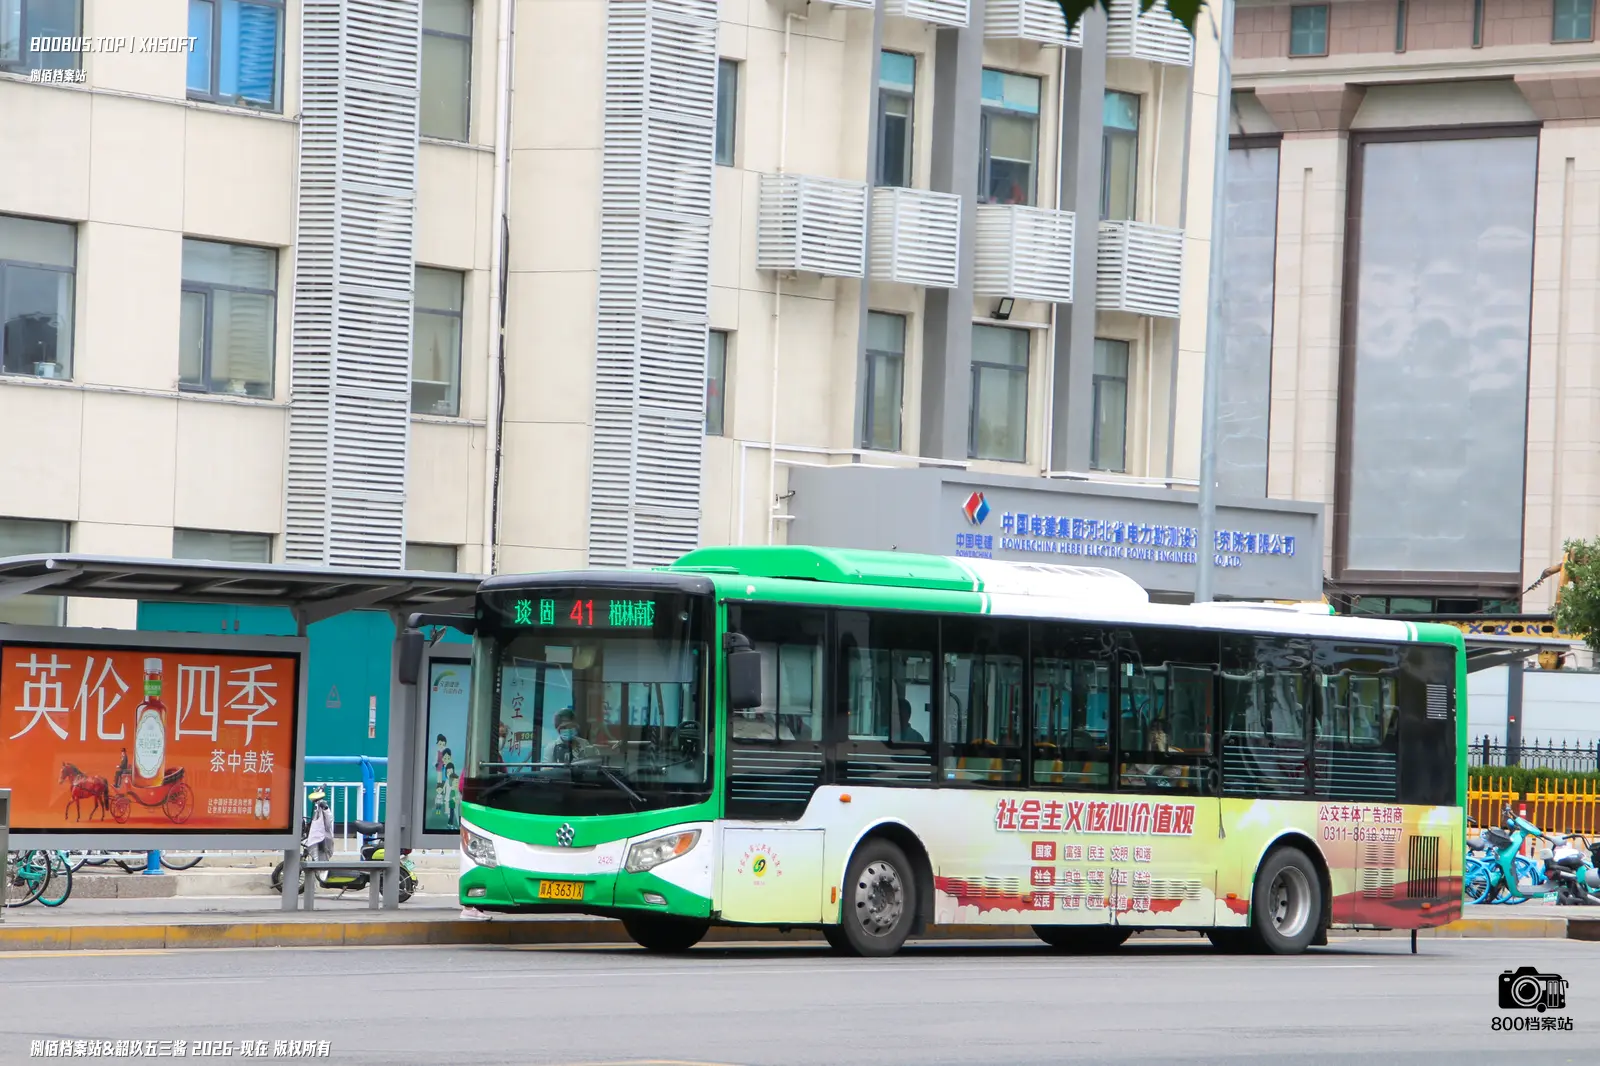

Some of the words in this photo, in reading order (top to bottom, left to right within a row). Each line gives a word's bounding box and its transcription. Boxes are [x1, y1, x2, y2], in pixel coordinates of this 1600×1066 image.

[955, 533, 993, 550] 中国电建
[1000, 511, 1296, 556] 中国电建集团河北省电力勘测设究院有限公司
[955, 549, 993, 559] POWERCHINA
[1000, 537, 1056, 553] POWERCHINA
[1058, 541, 1083, 556] HEBEI
[1084, 544, 1124, 559] ELECTRIC
[1124, 547, 1155, 562] POWER
[1155, 549, 1199, 564] ENGINEER
[570, 600, 593, 626] 41
[9, 653, 130, 741] 英伦
[174, 663, 278, 747] 四季
[210, 748, 275, 774] 茶中贵族
[996, 798, 1196, 835] 社会主义核心价值观
[1319, 805, 1403, 824] 公交车体广告招商
[1035, 844, 1052, 858] 国家
[1064, 844, 1082, 860] 富强
[1088, 845, 1105, 861] 民主
[1111, 846, 1129, 861] 文明
[1134, 846, 1151, 862] 和谐
[1033, 869, 1051, 884] 社会
[1063, 869, 1082, 886] 自由
[1087, 870, 1105, 886] 平等
[1110, 870, 1128, 886] 公正
[1033, 893, 1051, 908] 公民
[1062, 894, 1081, 909] 爱国
[1087, 894, 1105, 910] 敬业
[1132, 894, 1151, 911] 友善
